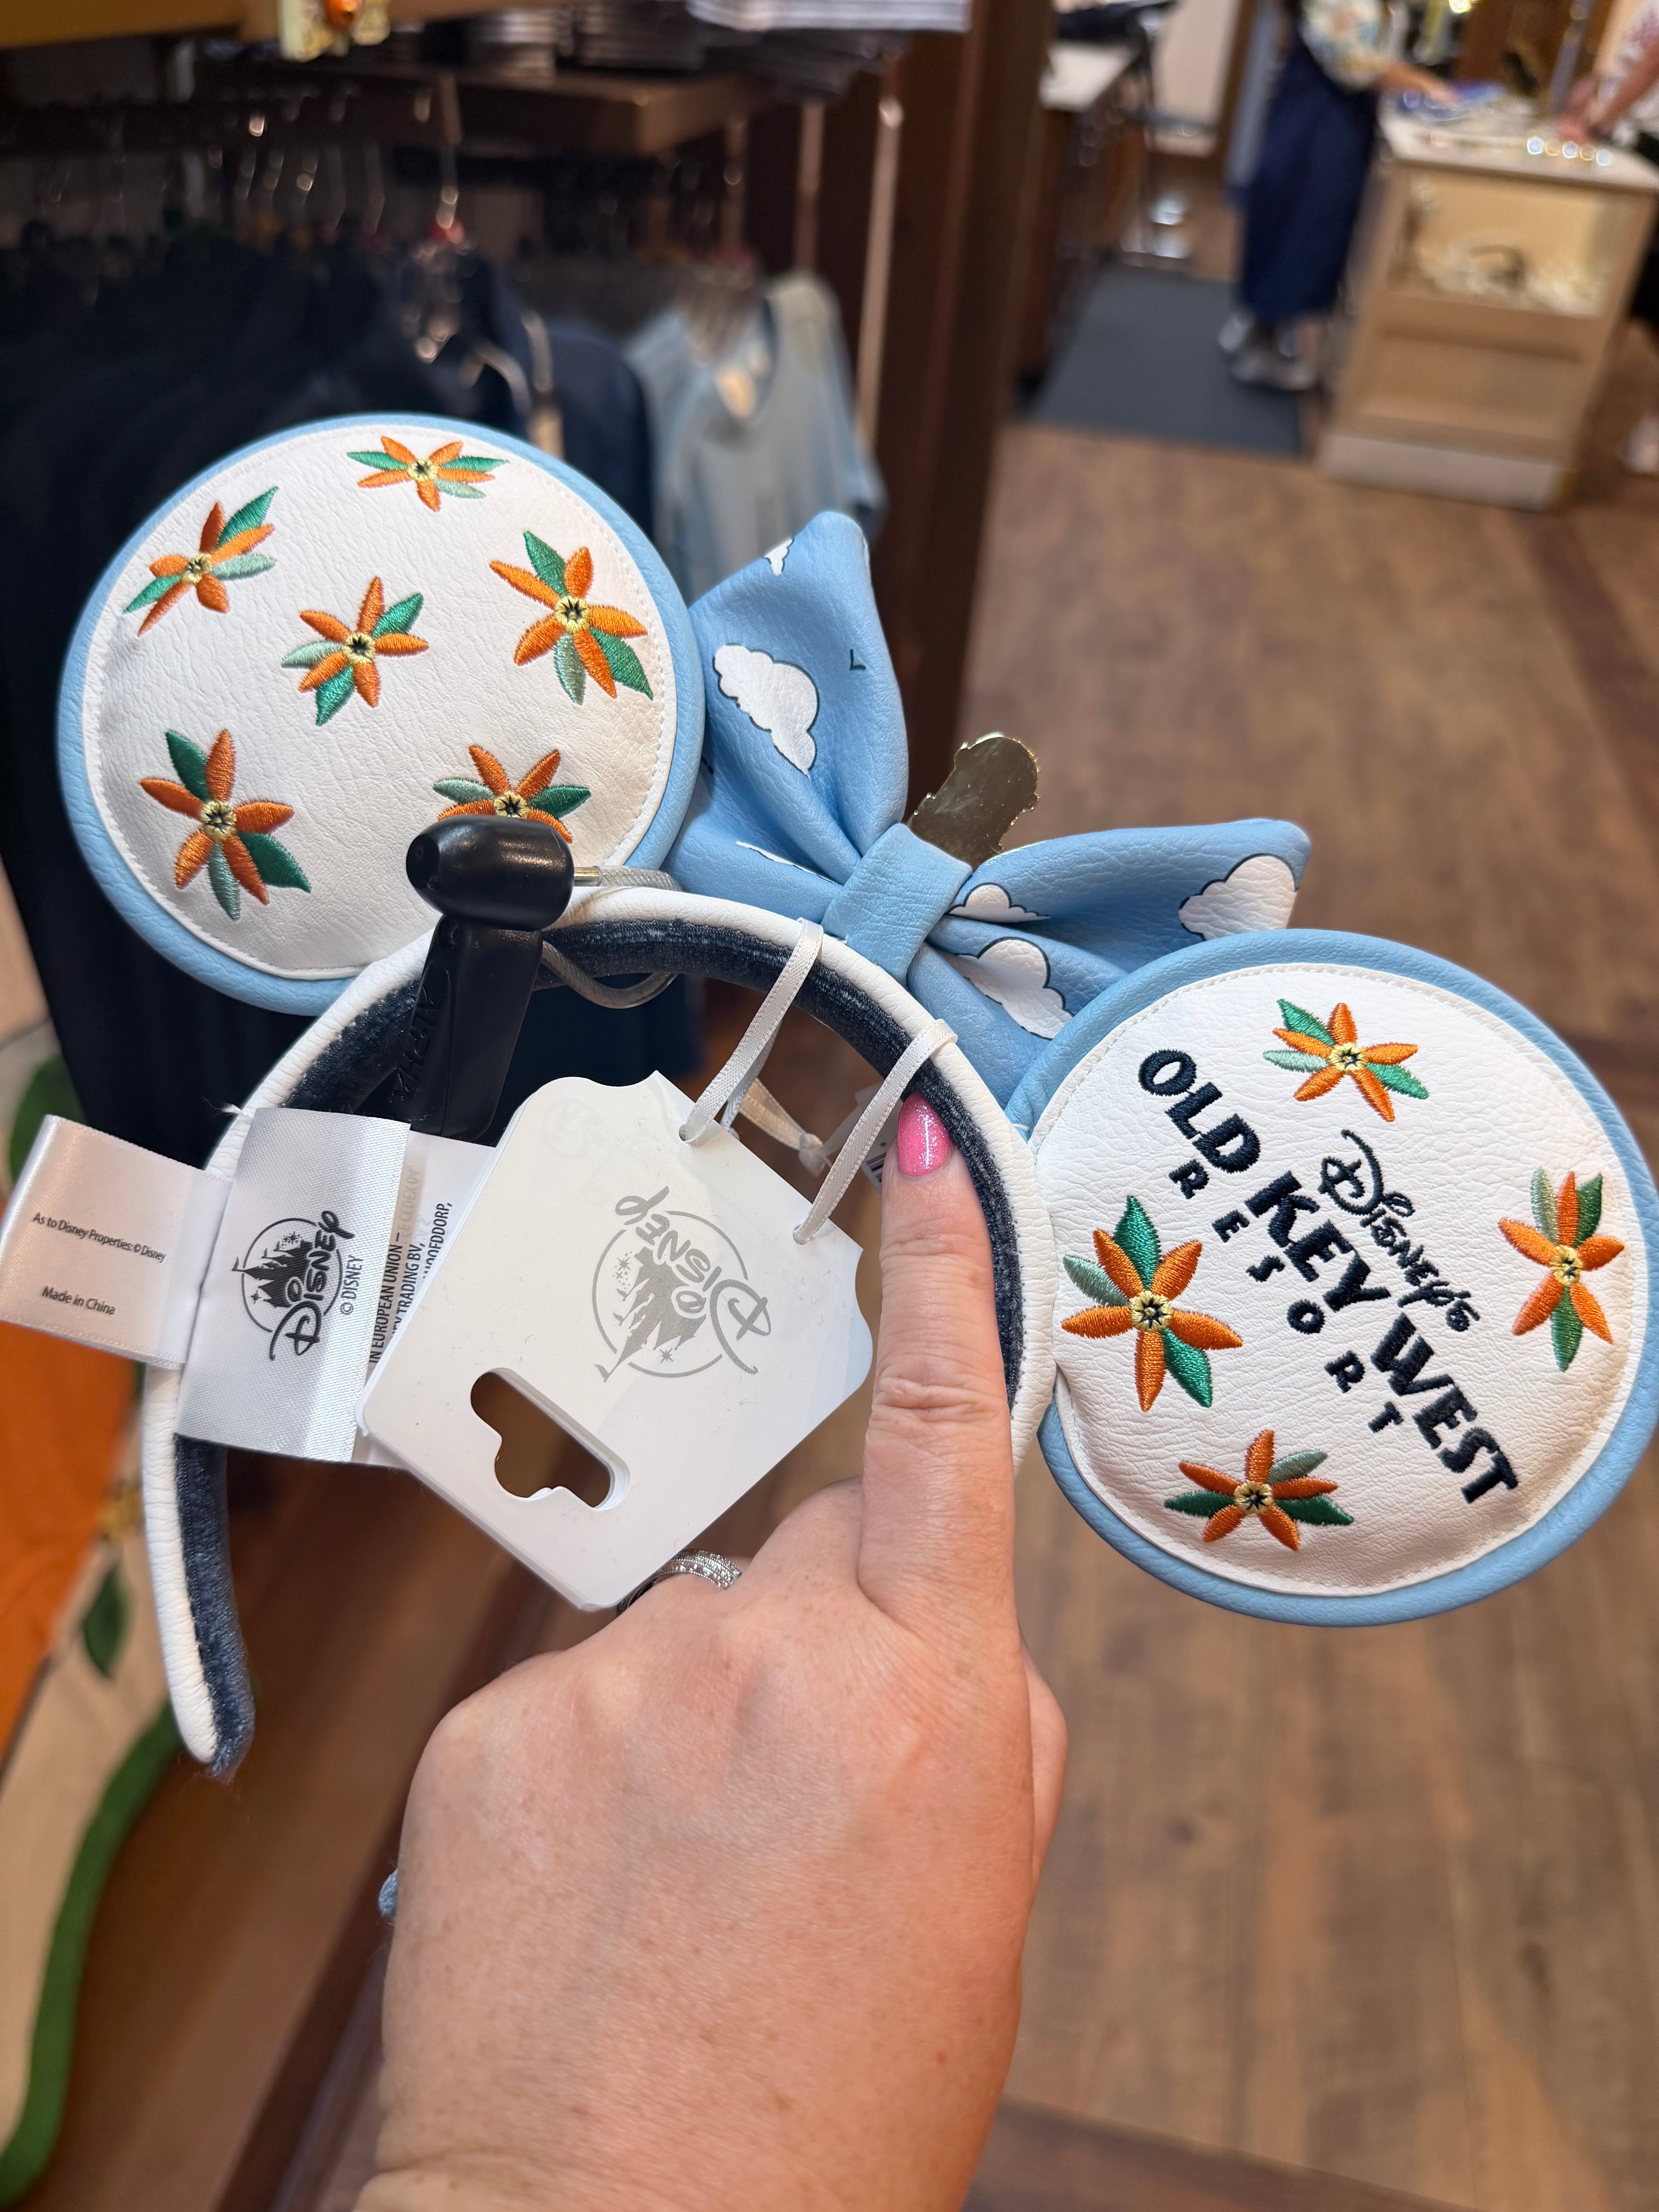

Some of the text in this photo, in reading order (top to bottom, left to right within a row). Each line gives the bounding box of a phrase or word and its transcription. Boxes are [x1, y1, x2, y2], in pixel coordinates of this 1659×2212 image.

[33, 1212, 45, 1224] As
[47, 1217, 57, 1228] to
[58, 1220, 89, 1239] Disney
[88, 1229, 133, 1251] Properties:
[141, 1245, 167, 1263] Disney
[383, 1244, 403, 1282] UNION
[407, 1243, 425, 1261] BV,
[425, 1202, 452, 1273] OOFDDORP,
[42, 1286, 116, 1315] Made in China
[341, 1255, 363, 1299] DISNEY
[397, 1262, 420, 1314] TRADING
[1138, 1049, 1519, 1504] OLD KEY WEST
[372, 1284, 395, 1348] EUROPEAN
